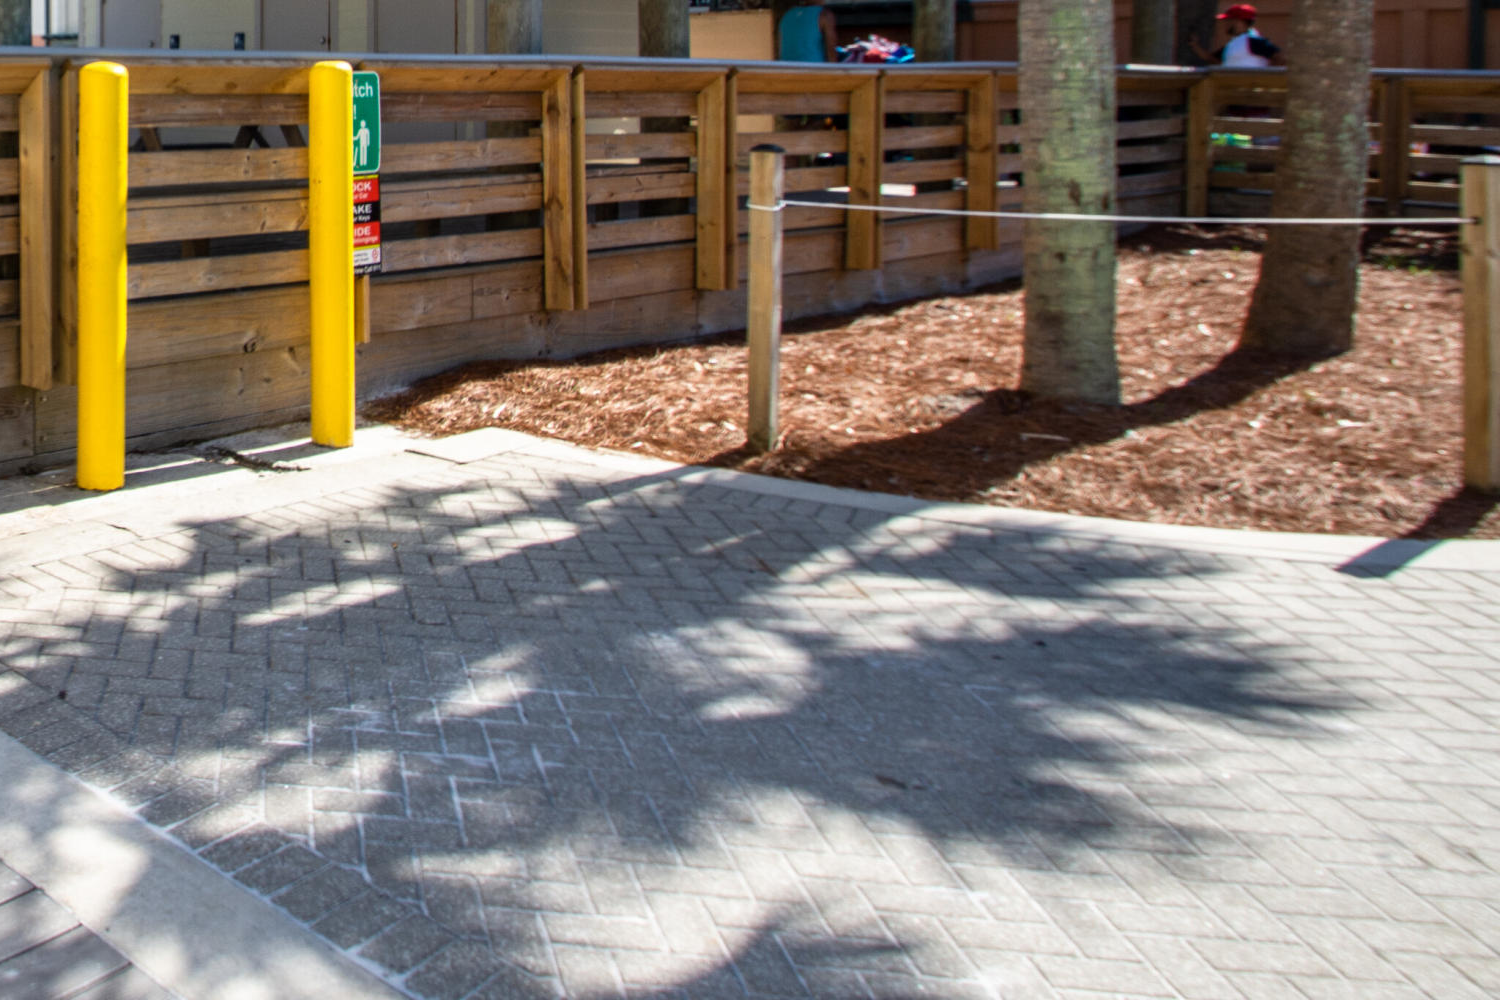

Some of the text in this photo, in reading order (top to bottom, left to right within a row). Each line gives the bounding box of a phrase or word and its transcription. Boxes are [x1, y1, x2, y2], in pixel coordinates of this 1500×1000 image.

[353, 81, 374, 98] tch
[353, 181, 372, 193] OCK
[353, 203, 372, 214] AKE
[353, 226, 371, 237] IDE
